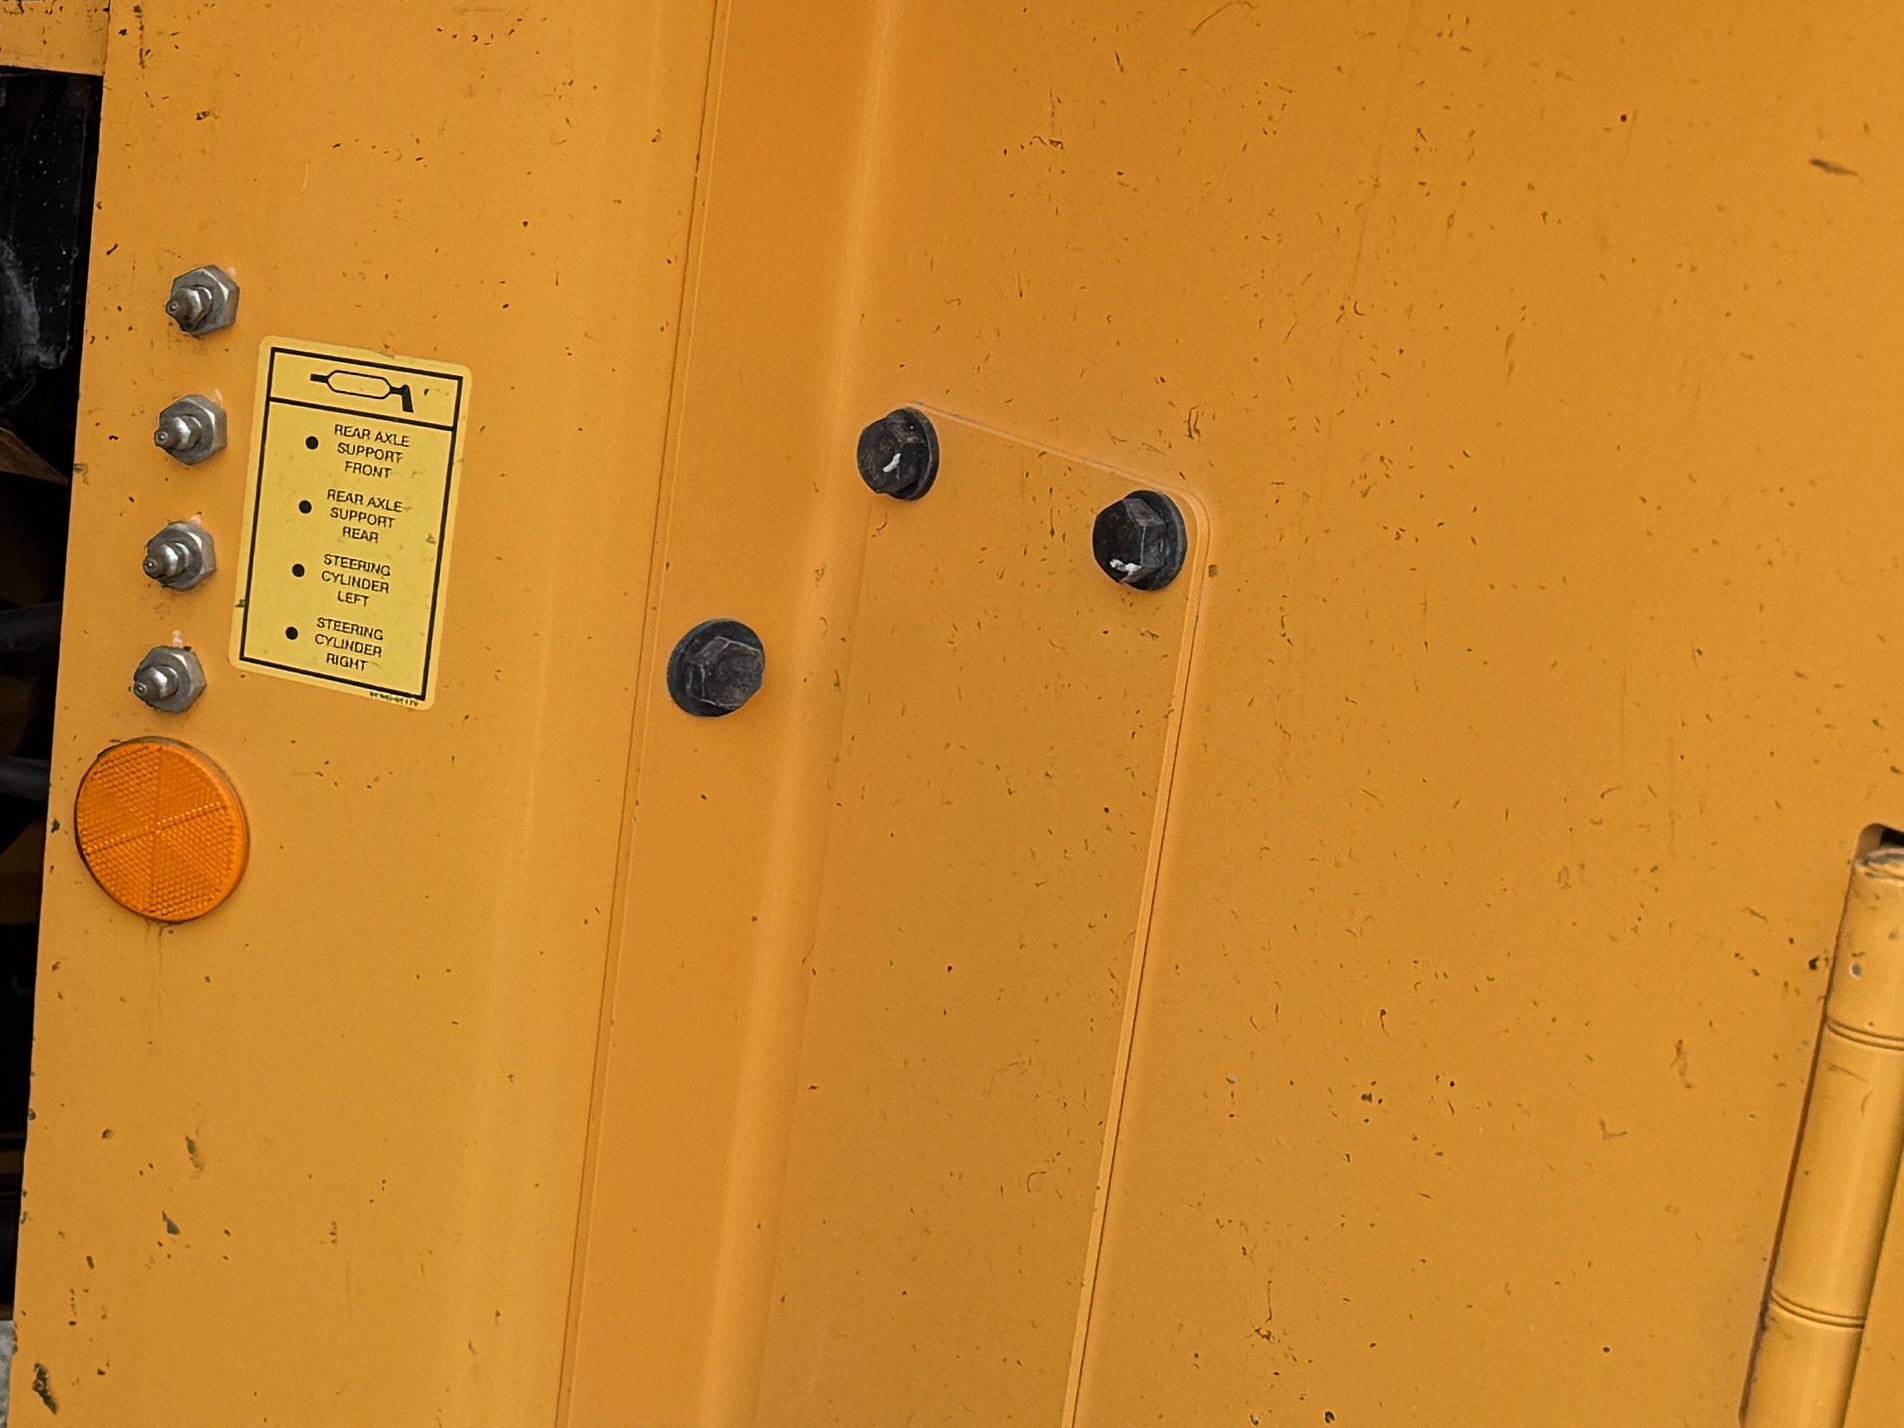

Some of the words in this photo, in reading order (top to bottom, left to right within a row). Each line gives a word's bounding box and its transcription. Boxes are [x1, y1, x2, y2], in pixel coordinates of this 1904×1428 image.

[334, 424, 370, 439] REAR
[375, 431, 410, 447] AXLE
[337, 443, 404, 463] SUPPORT
[344, 462, 391, 478] FRONT
[327, 489, 363, 505] REAR
[367, 496, 403, 513] AXLE
[330, 507, 396, 529] SUPPORT
[342, 526, 378, 543] REAR
[324, 554, 391, 577] STEERING
[321, 571, 389, 593] CYLINDER
[337, 591, 370, 607] LEFT
[316, 617, 384, 641] STEERING
[315, 634, 382, 657] CYLINDER
[326, 653, 367, 671] RIGHT
